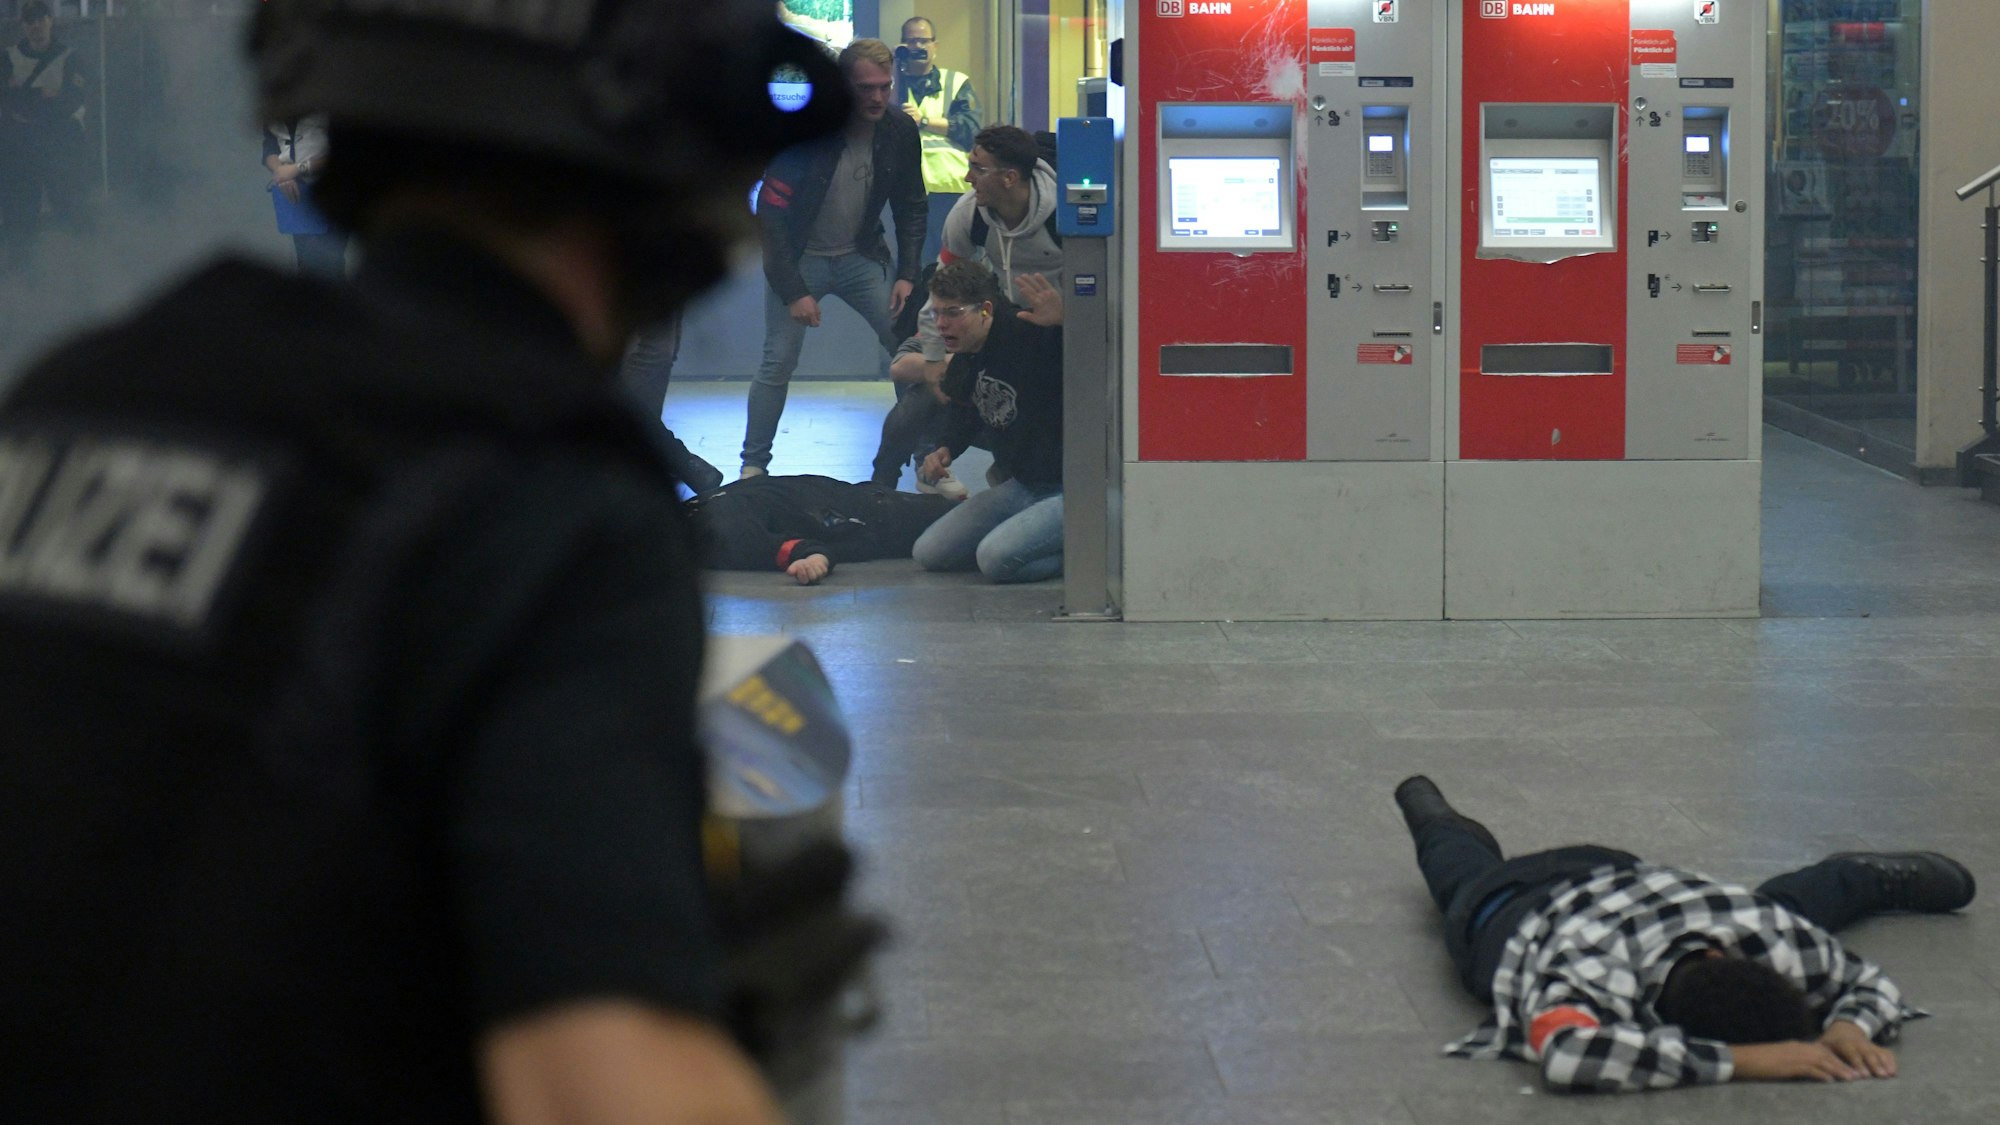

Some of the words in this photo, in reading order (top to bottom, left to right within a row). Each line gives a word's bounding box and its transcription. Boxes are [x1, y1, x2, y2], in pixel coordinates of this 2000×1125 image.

[1161, 1, 1180, 13] DB
[1189, 2, 1232, 15] BAHN
[1484, 2, 1504, 15] DB
[1512, 3, 1555, 16] BAHN
